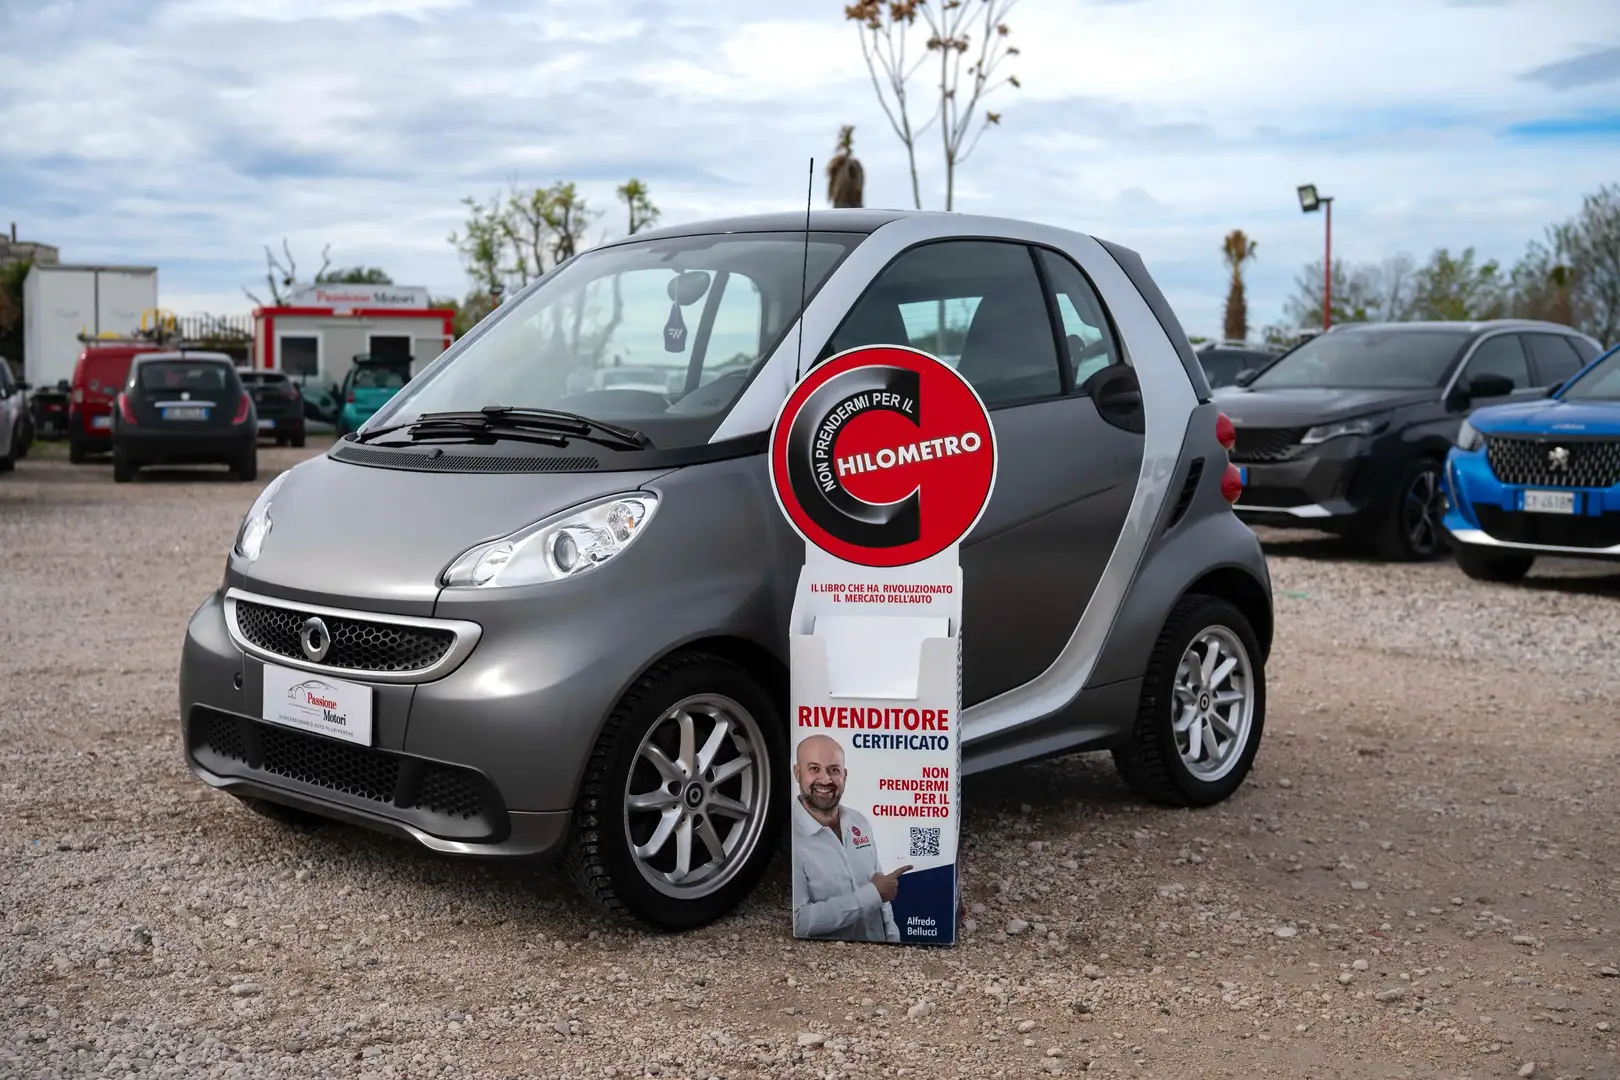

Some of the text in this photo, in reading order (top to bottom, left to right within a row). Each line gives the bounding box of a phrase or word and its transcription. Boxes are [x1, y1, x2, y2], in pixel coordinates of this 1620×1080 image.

[816, 392, 914, 492] NON PRENDERMI PER IL
[811, 583, 953, 594] IL LIBRO CHE HA RIVOLUZIONATO
[833, 594, 842, 603] IL
[844, 594, 886, 604] MERCATO
[307, 692, 337, 710] Passione
[323, 709, 347, 726] Motori
[798, 705, 949, 731] RIVENDITORE
[852, 733, 949, 750] CERTIFICATO
[922, 767, 949, 779] NON
[879, 778, 949, 792] PRENDERMI
[914, 793, 950, 805] PER IL
[872, 804, 949, 818] CHILOMETRO
[906, 916, 936, 926] Alfredo
[907, 927, 938, 937] Bellucci
